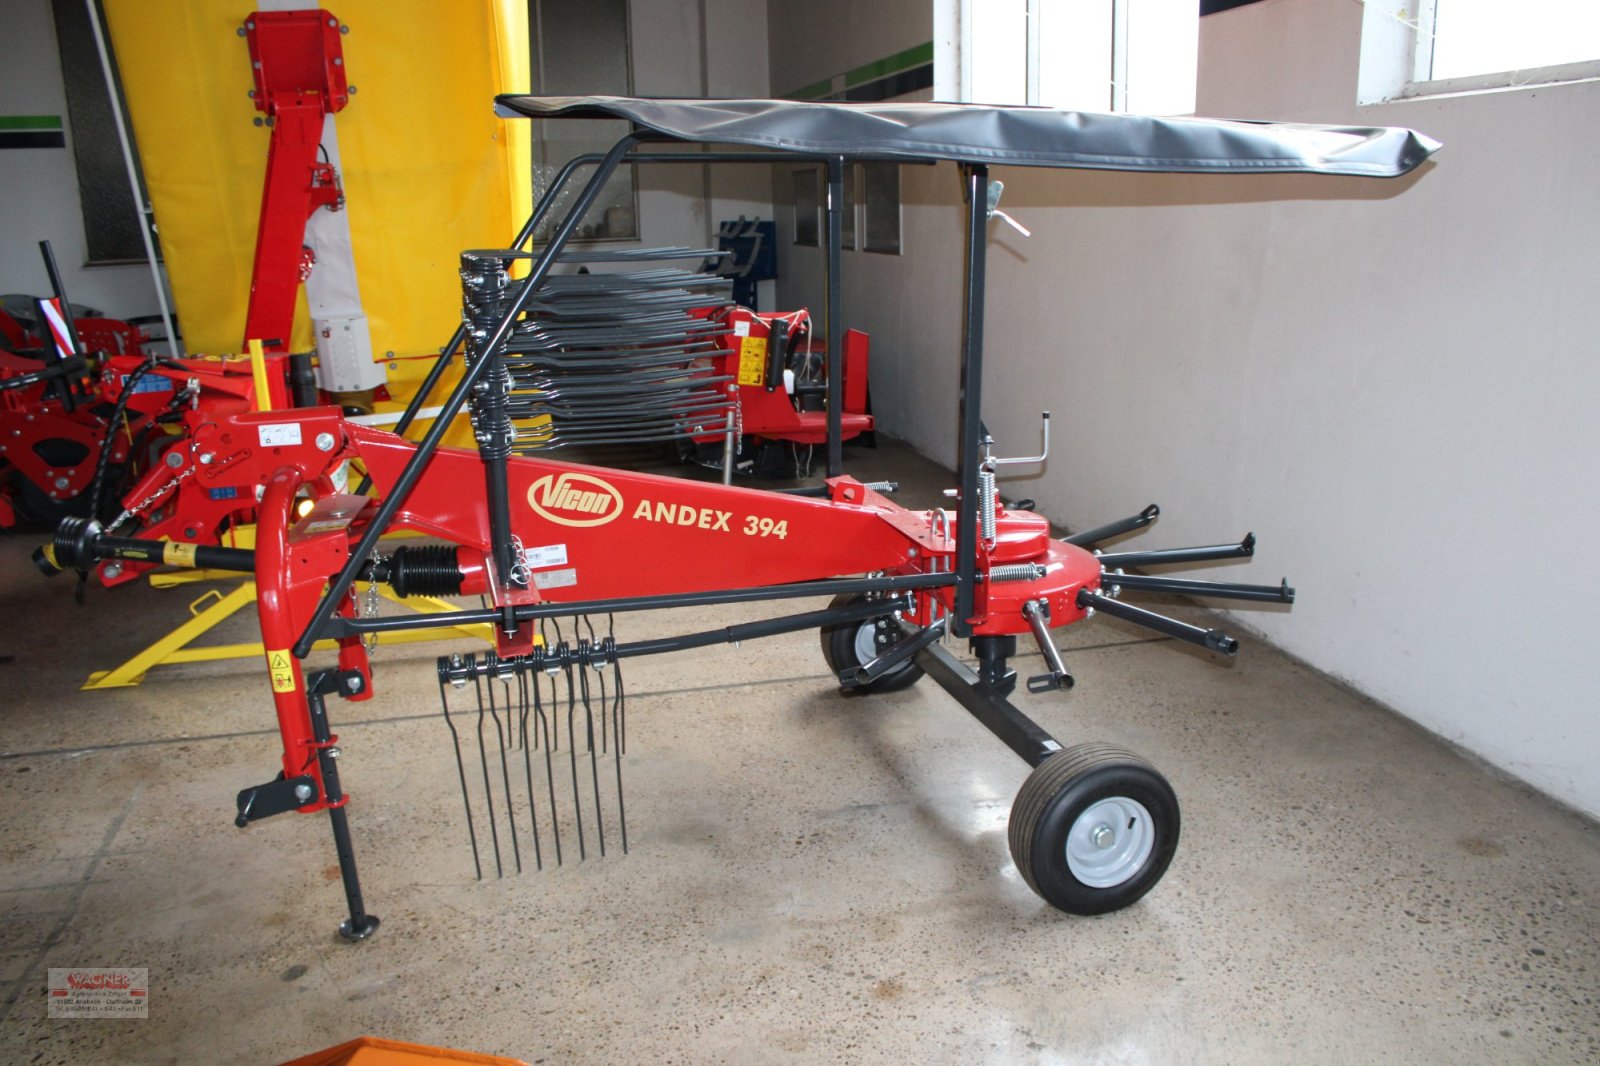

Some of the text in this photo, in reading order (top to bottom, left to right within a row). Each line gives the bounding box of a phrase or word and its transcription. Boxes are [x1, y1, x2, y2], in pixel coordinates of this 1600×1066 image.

[541, 475, 612, 514] Vicon
[633, 499, 789, 540] ANDEX 394
